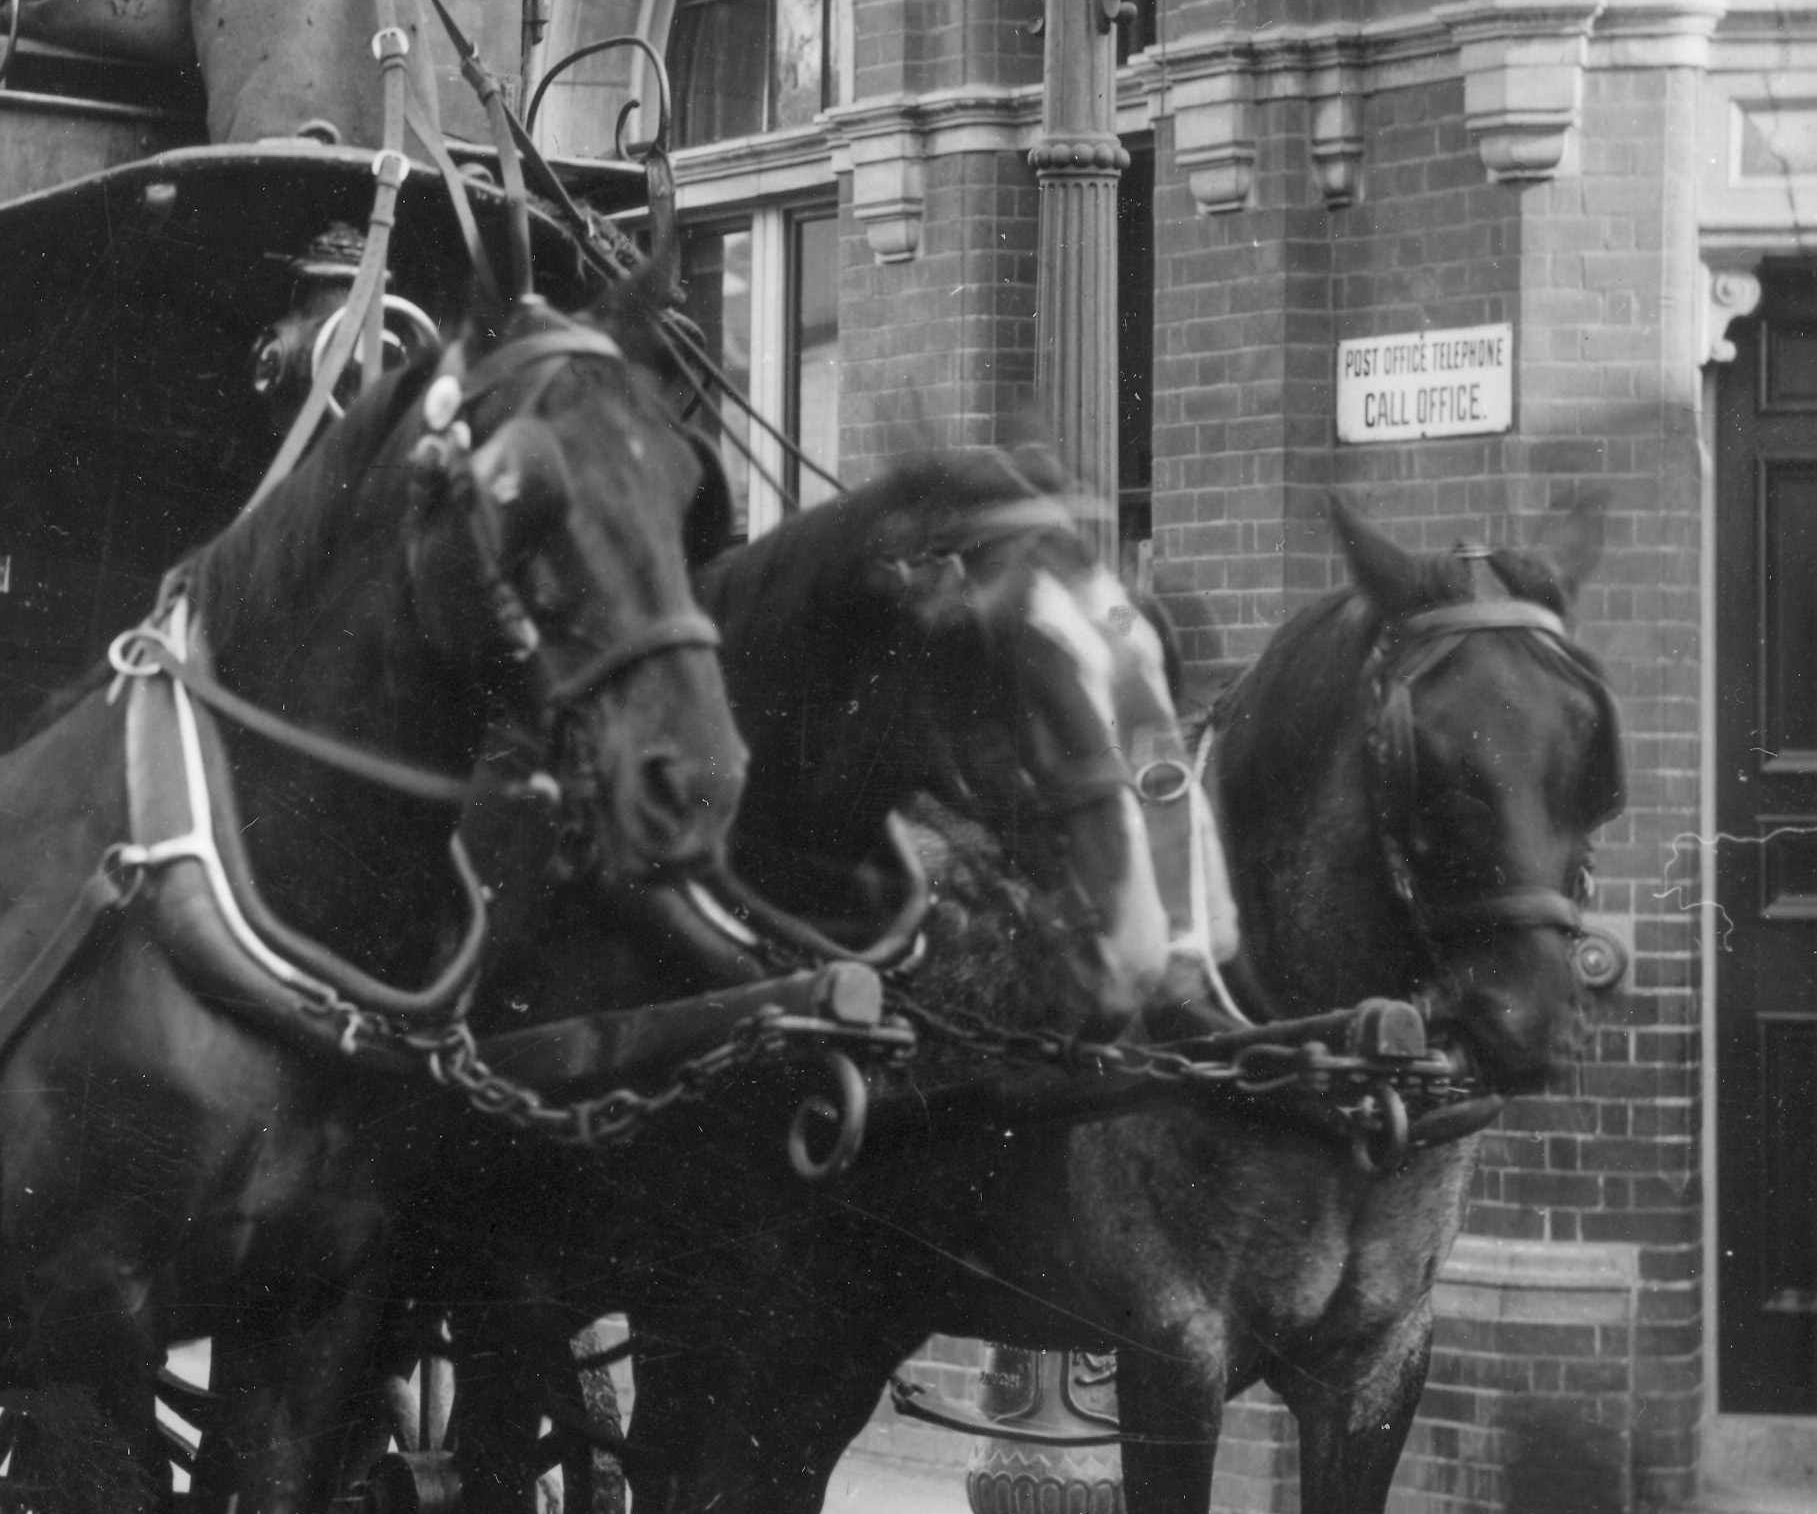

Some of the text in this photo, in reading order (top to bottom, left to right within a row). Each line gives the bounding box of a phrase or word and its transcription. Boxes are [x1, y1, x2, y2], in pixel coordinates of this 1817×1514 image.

[1345, 337, 1504, 379] POST OFFICE TELEPHONE
[1365, 383, 1487, 428] CALL OFFICE.
